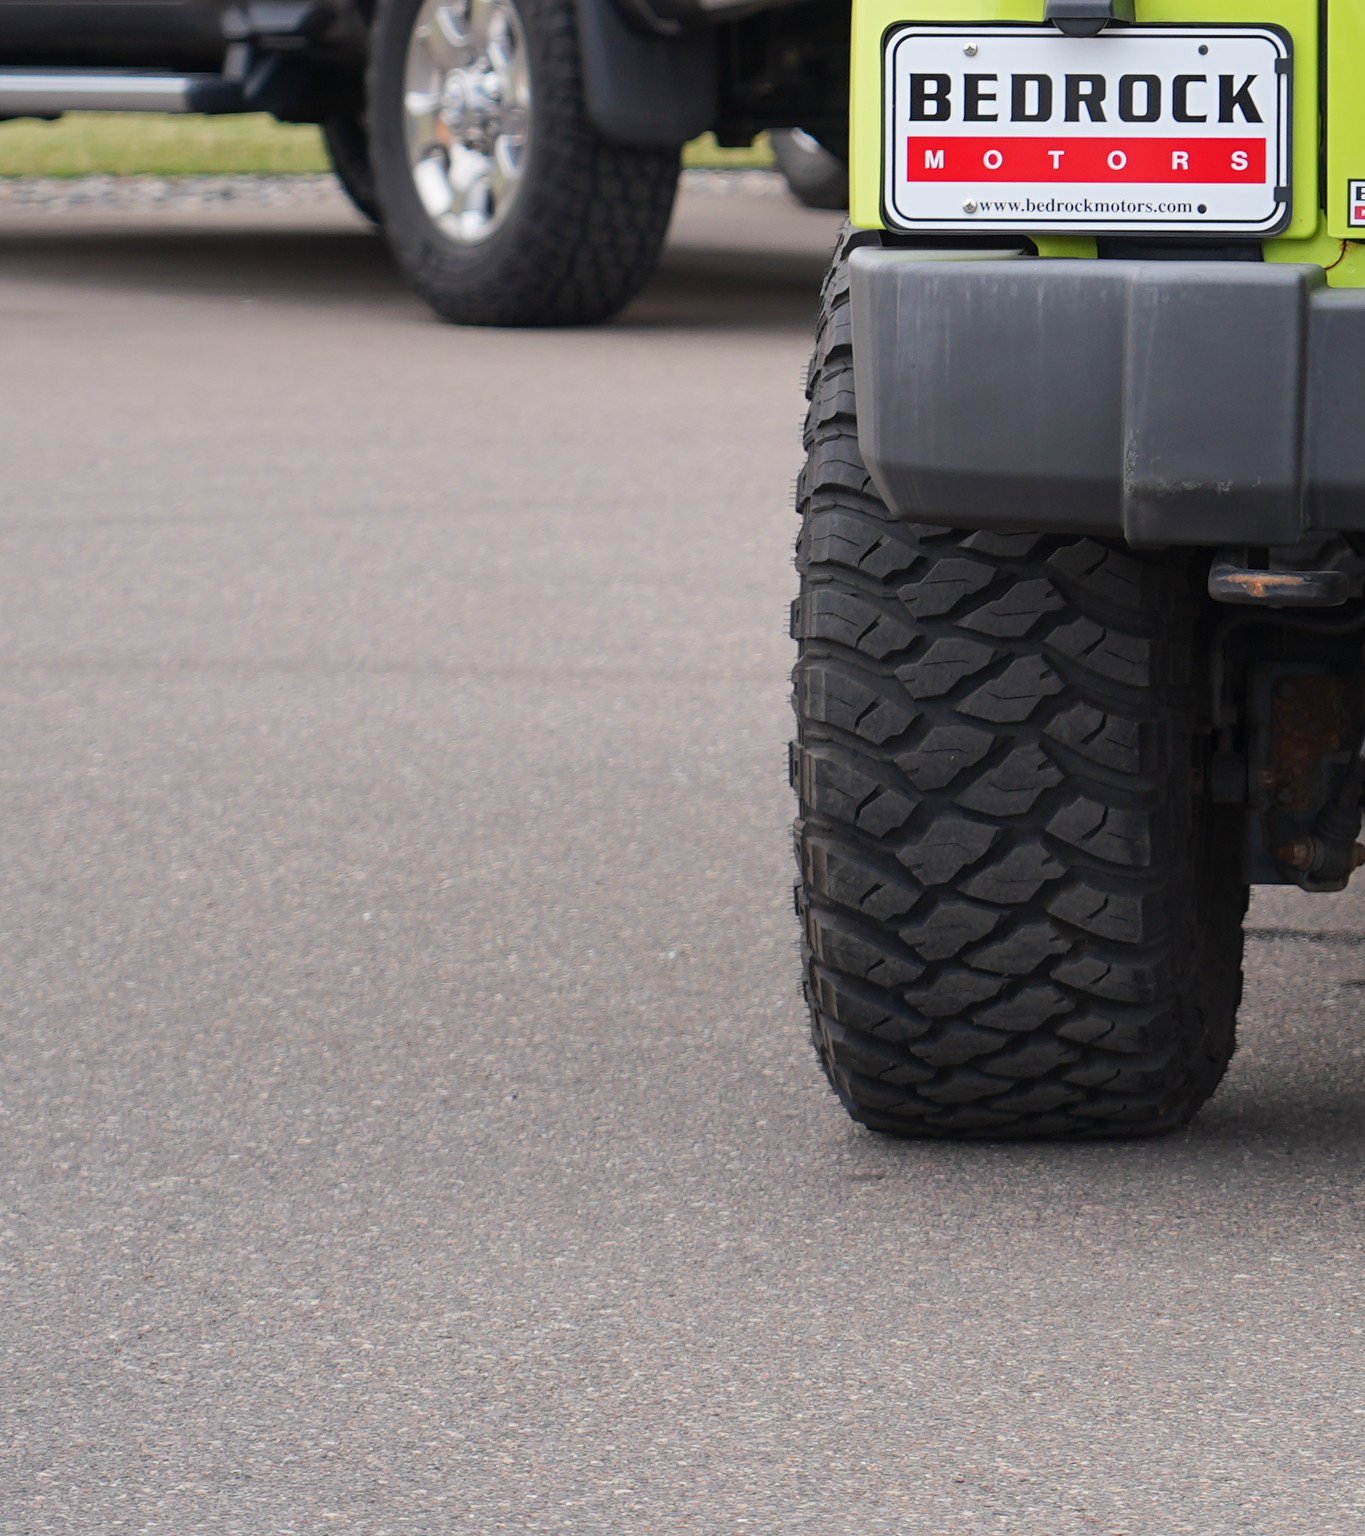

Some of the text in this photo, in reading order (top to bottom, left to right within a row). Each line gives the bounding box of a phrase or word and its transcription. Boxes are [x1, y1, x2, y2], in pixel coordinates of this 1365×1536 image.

[908, 73, 1263, 123] BEDROCK
[925, 150, 1249, 171] MOTORS
[978, 197, 1193, 216] www.bedrockmotors.com
